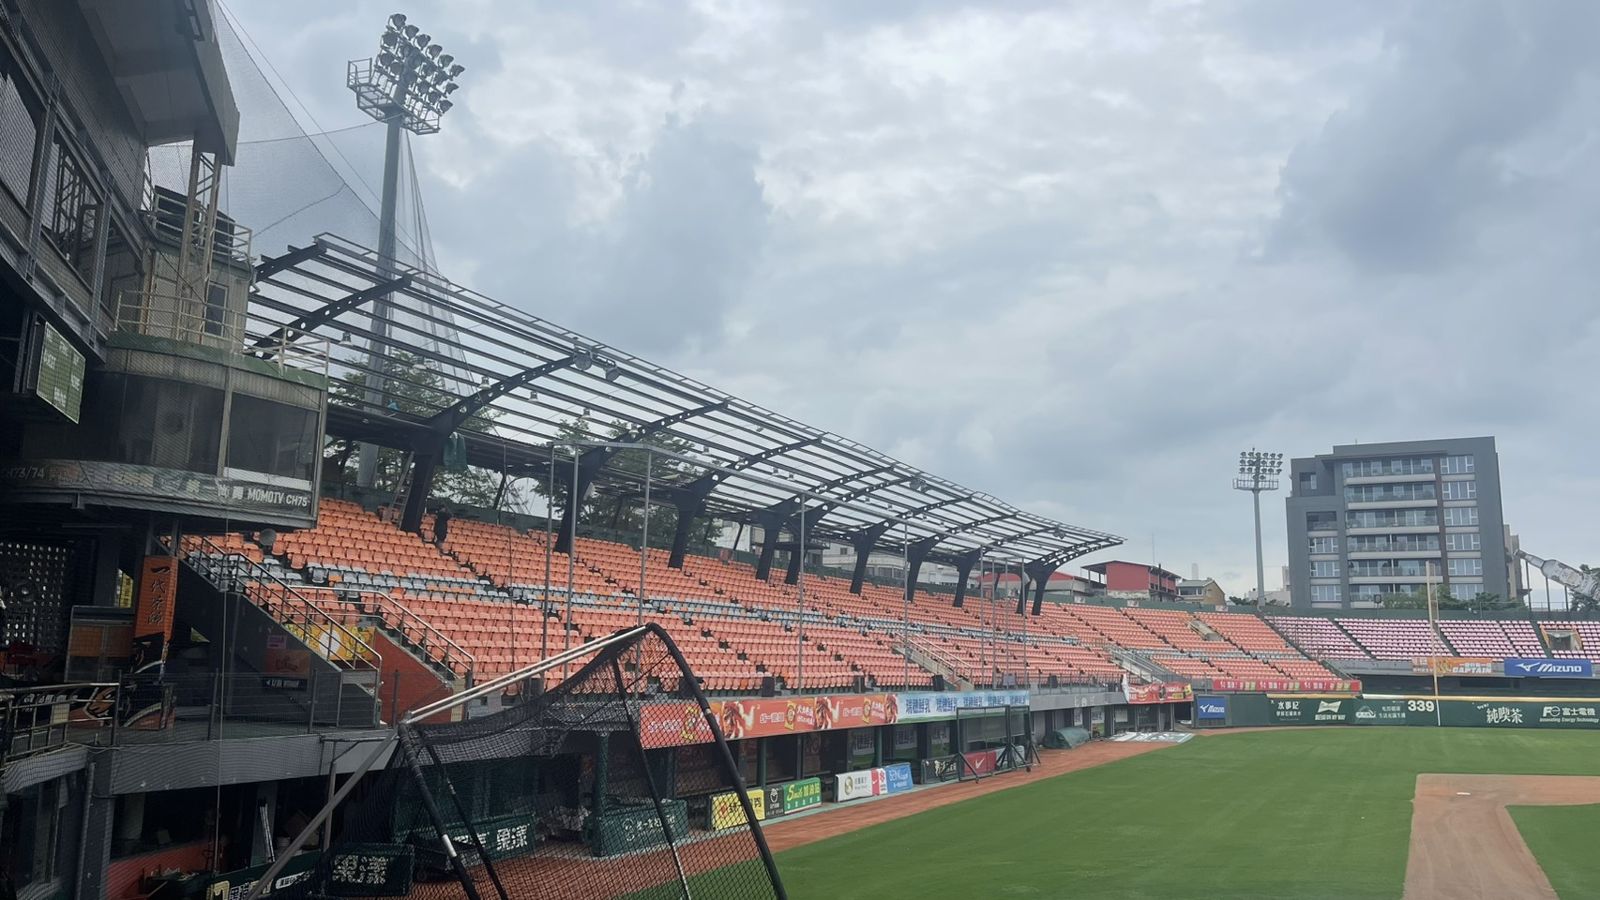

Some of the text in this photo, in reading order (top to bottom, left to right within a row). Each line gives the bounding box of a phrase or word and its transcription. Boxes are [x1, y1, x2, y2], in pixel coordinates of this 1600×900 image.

[247, 488, 284, 504] MOMOTV
[286, 494, 308, 507] CH75
[1408, 700, 1435, 712] 339
[1561, 707, 1596, 716] 富士電機
[1486, 706, 1523, 724] 純喫茶
